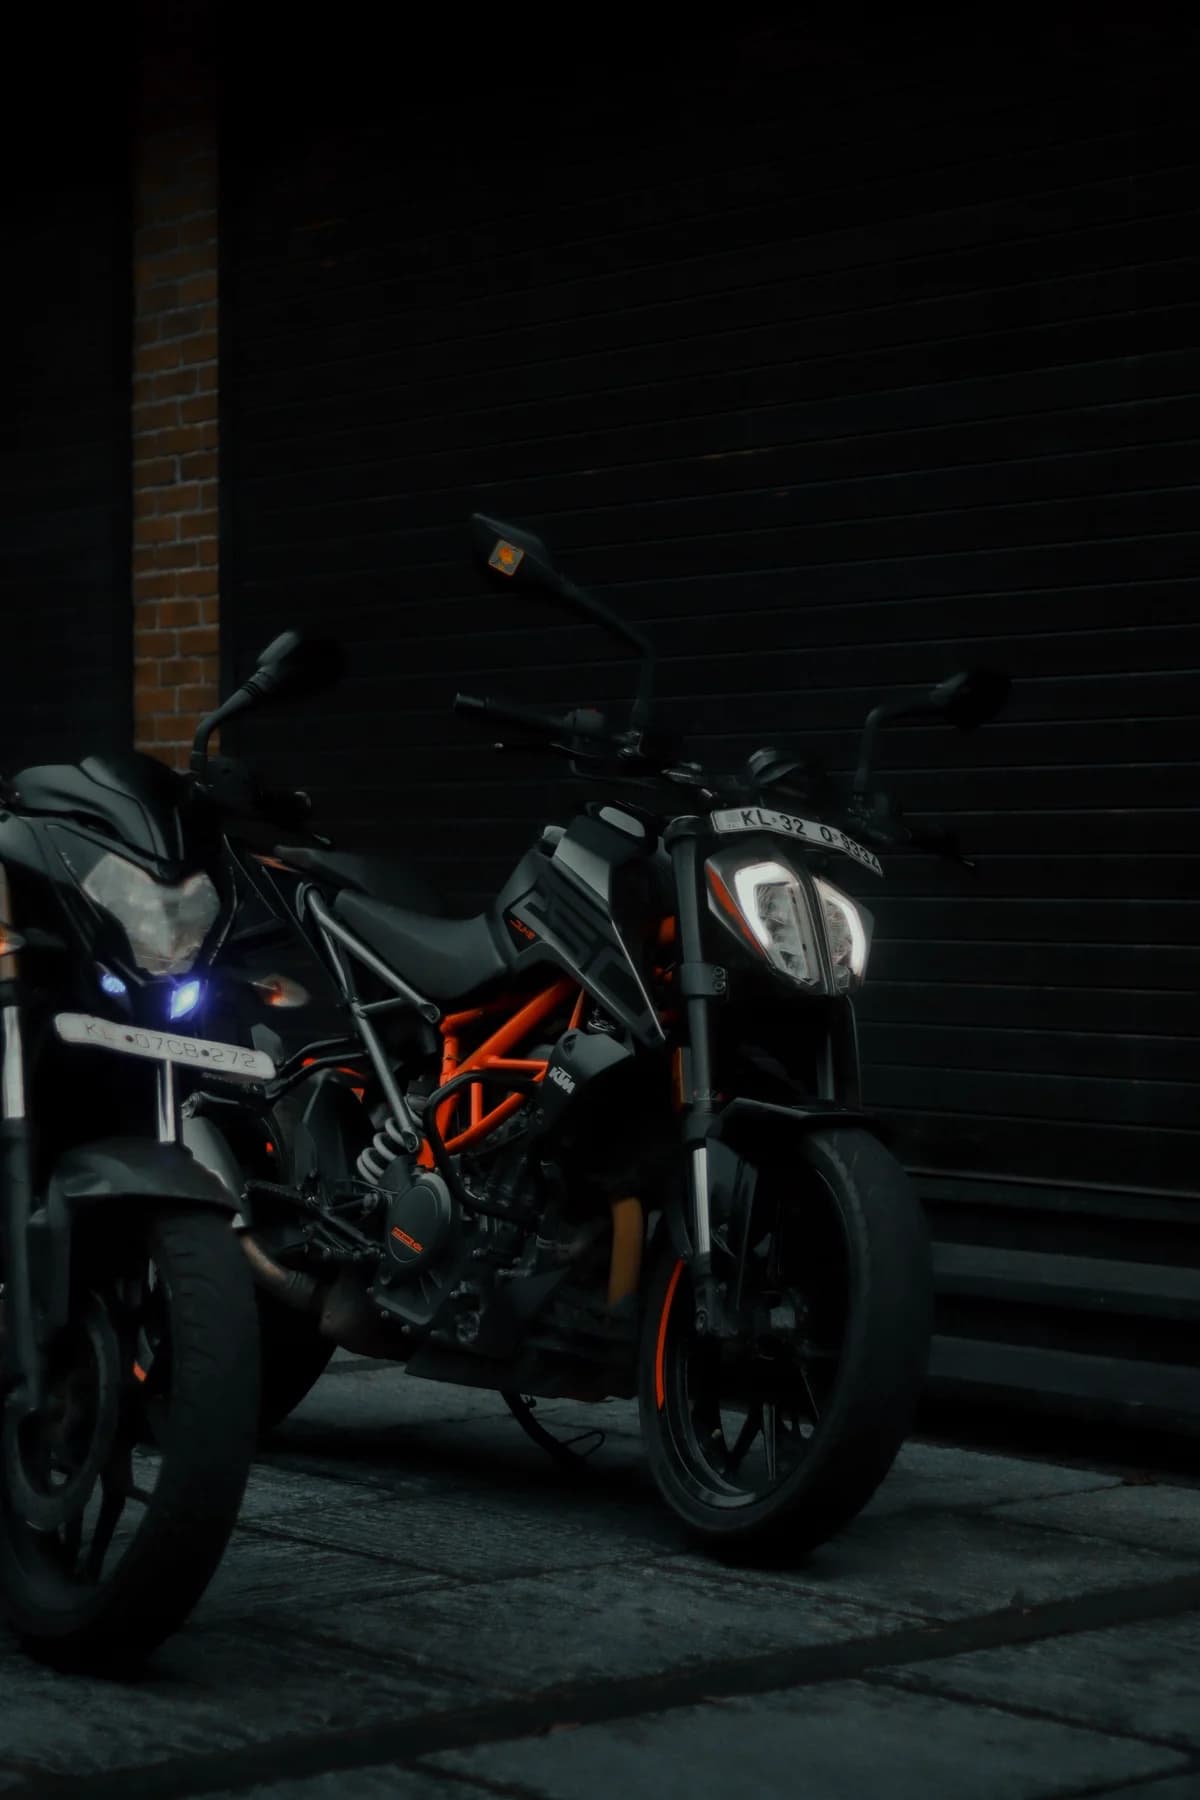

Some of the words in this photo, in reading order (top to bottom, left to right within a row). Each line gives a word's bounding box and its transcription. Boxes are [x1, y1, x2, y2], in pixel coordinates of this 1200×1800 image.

[740, 809, 772, 826] KL
[779, 814, 807, 836] 32
[548, 1066, 576, 1095] KTM
